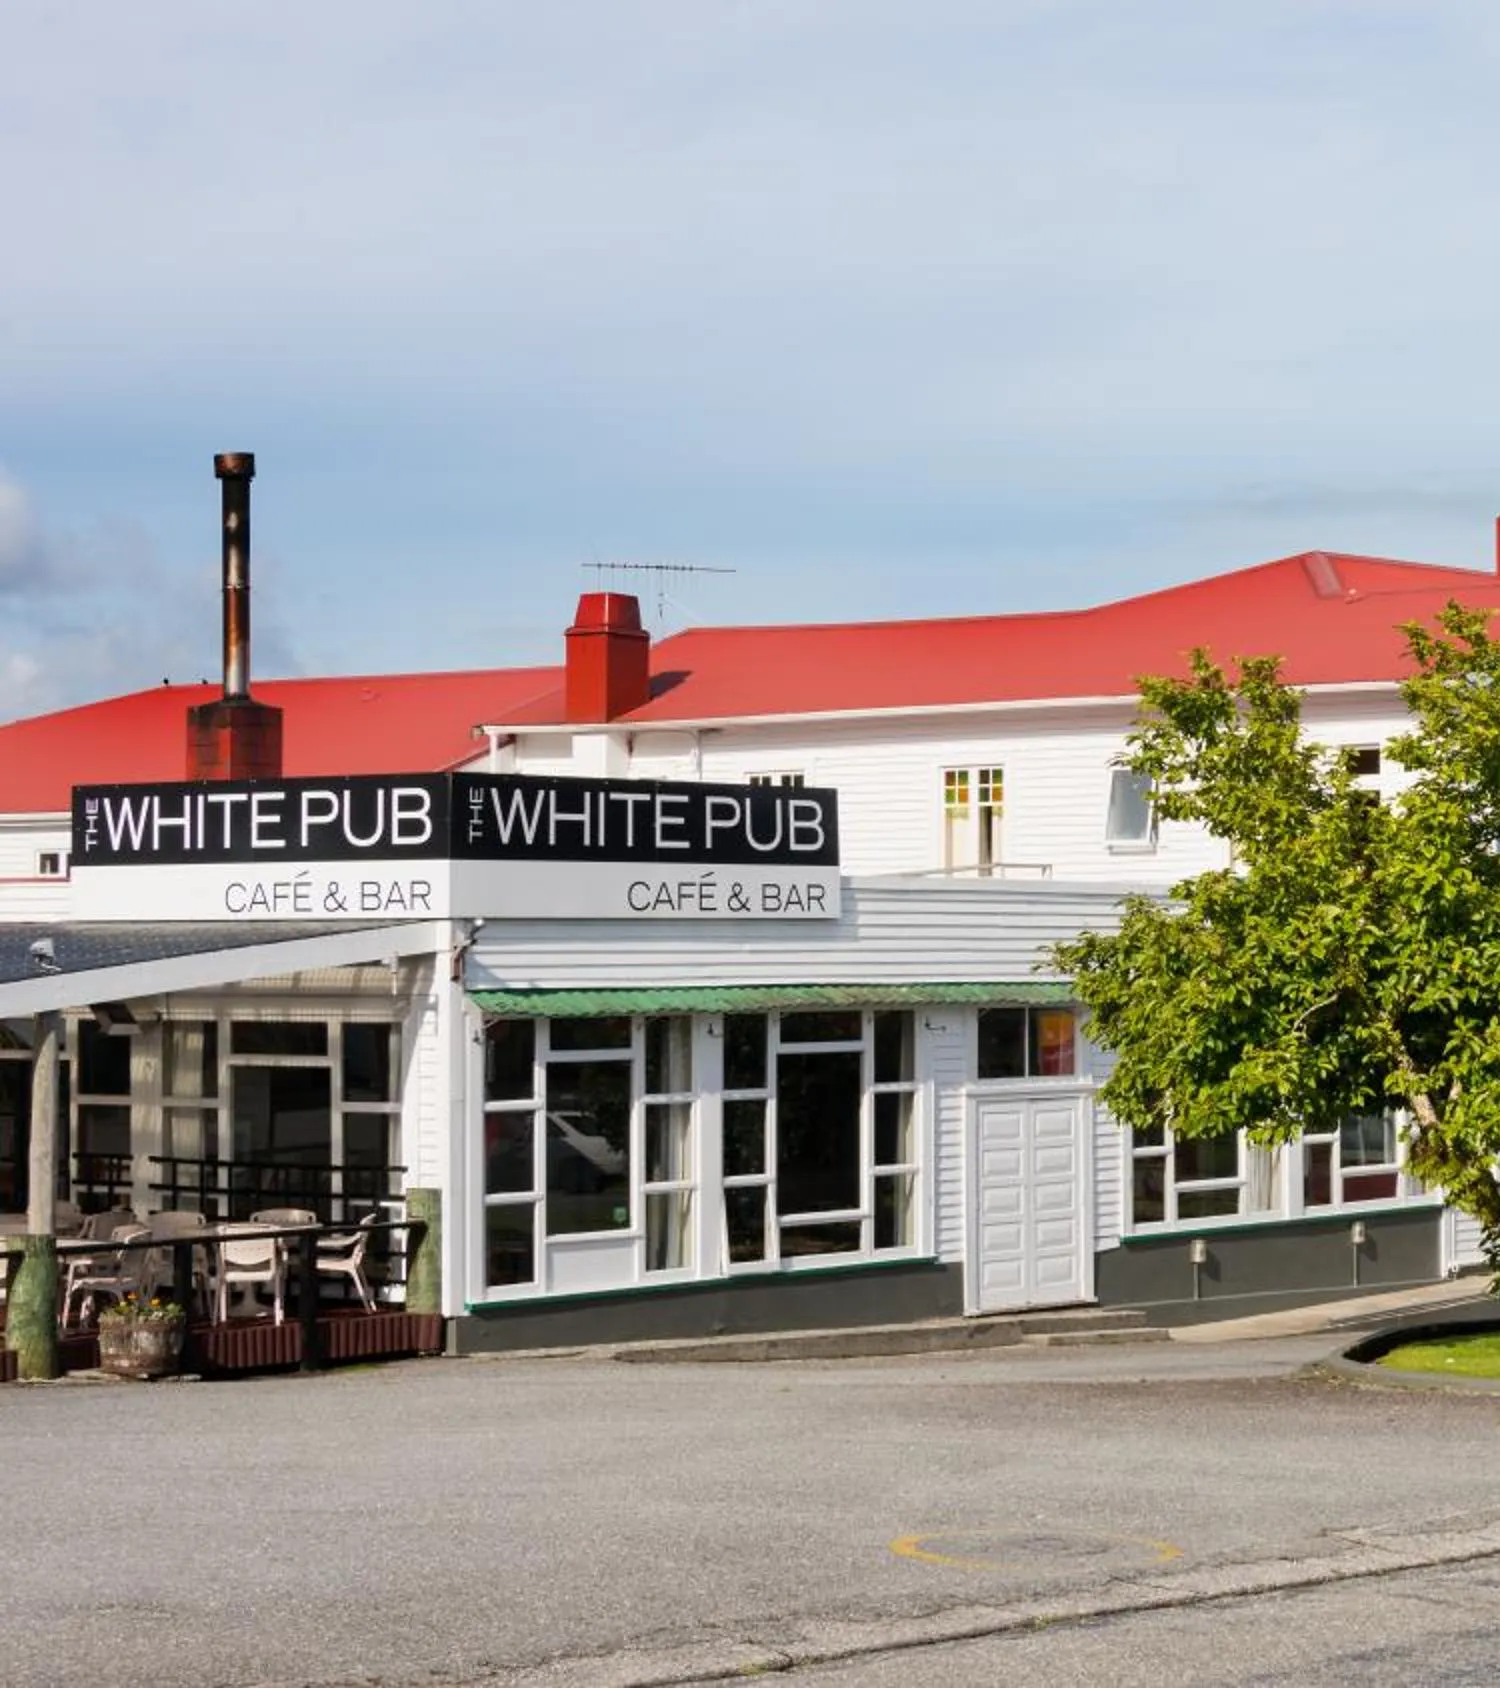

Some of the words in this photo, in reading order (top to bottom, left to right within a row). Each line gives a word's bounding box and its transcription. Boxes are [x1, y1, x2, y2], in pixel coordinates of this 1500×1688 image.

[85, 798, 99, 851] THE
[103, 791, 286, 851] WHITE
[300, 787, 432, 848] PUB
[468, 785, 484, 844] THE
[490, 787, 691, 849] WHITE
[705, 795, 824, 851] PUB
[224, 870, 313, 913] CAFÉ
[322, 881, 348, 912] &
[360, 881, 432, 911] BAR
[626, 871, 717, 912] CAFÉ
[726, 882, 751, 912] &
[761, 884, 826, 912] BAR
